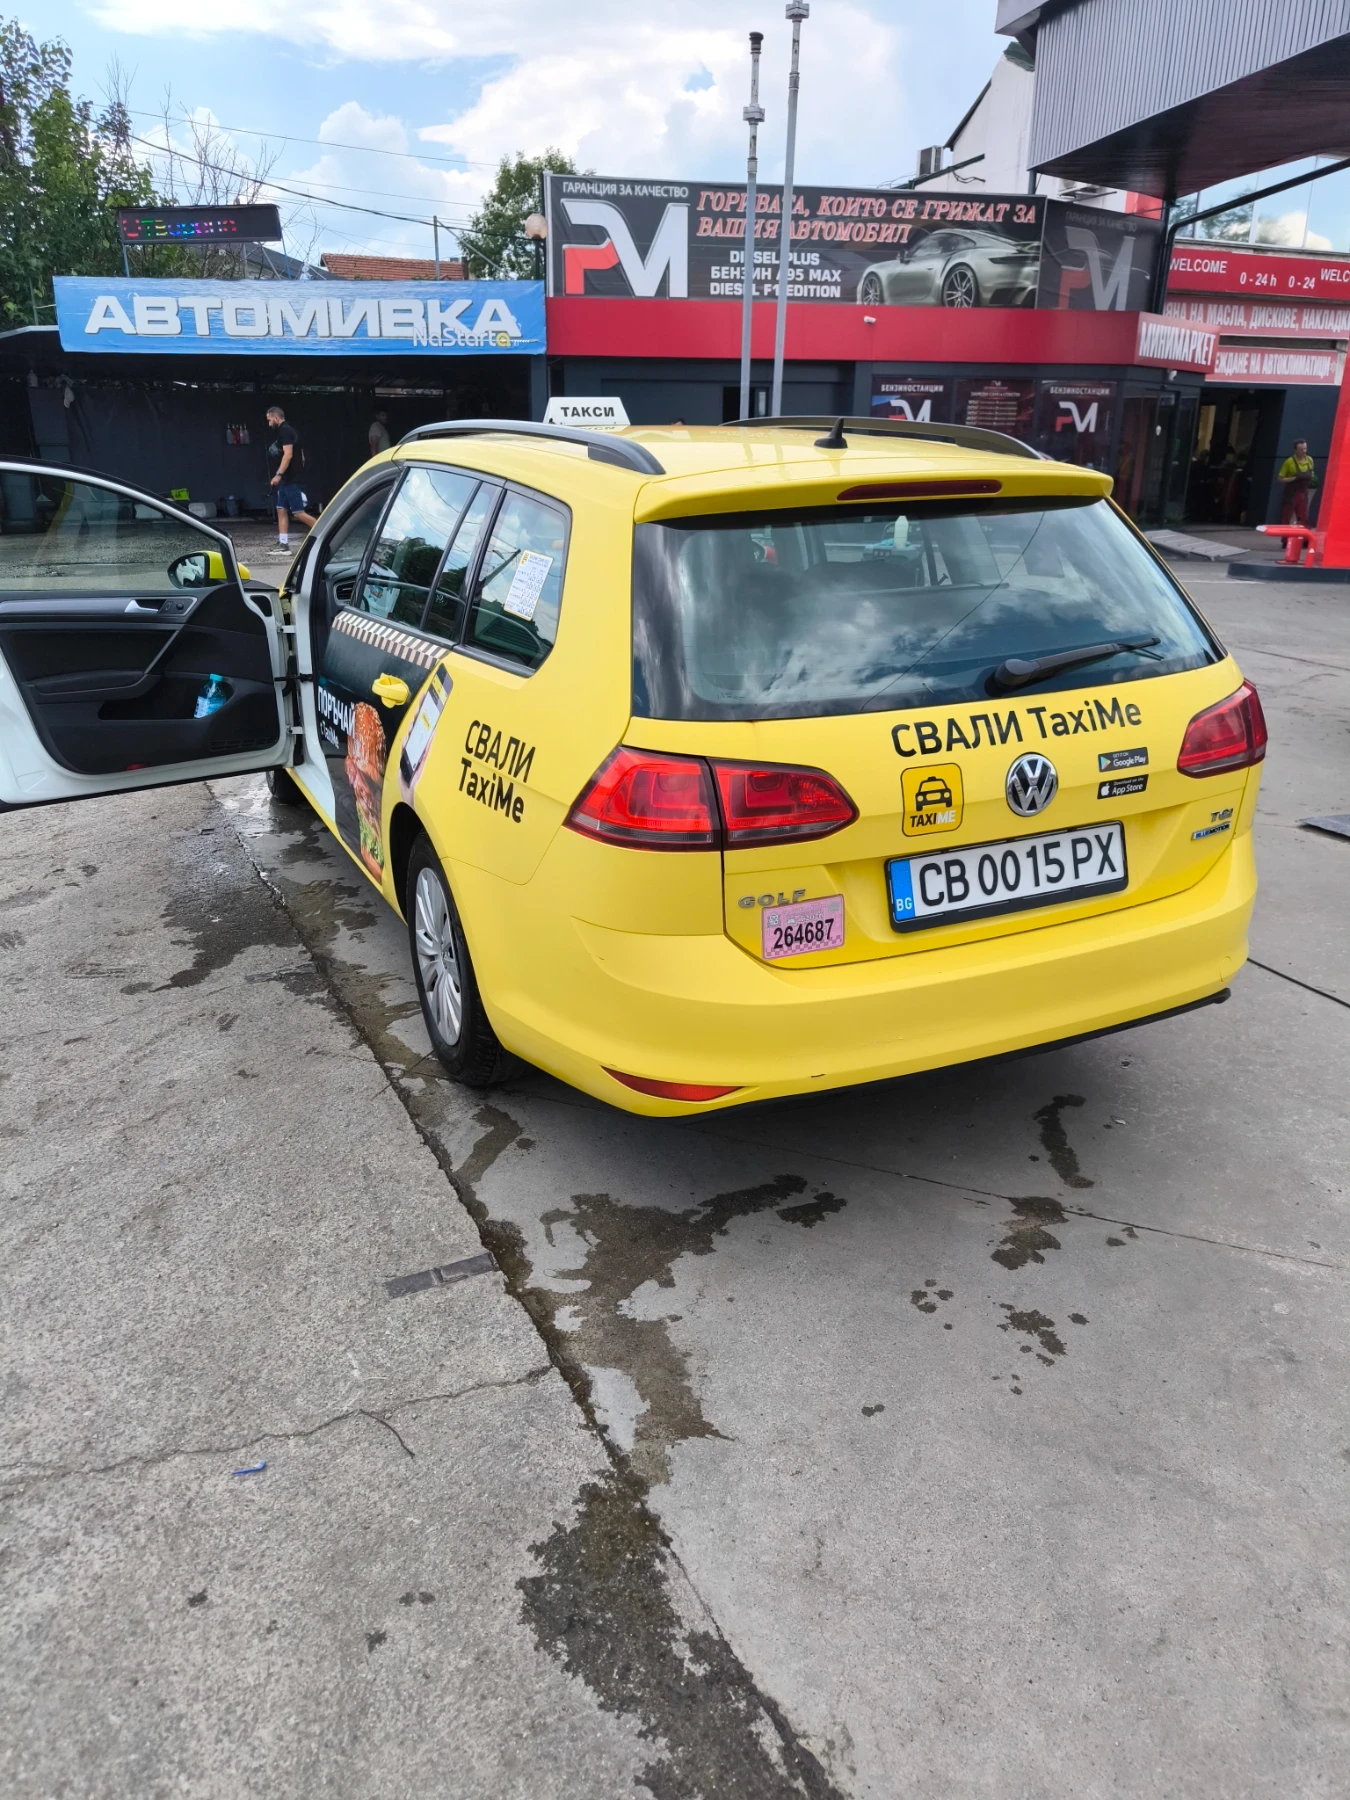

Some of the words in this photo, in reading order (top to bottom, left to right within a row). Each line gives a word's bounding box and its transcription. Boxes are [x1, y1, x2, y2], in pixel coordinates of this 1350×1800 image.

[562, 181, 617, 197] ГАРАНЦИЯ
[618, 184, 633, 196] ЗА
[634, 185, 689, 198] КАЧЕСТВО
[891, 199, 918, 219] СЕ
[920, 200, 1010, 222] ГРИЖАТ
[1012, 204, 1036, 223] ЗА
[729, 250, 780, 265] DISEL
[1170, 257, 1228, 274] WELCOME
[709, 282, 760, 296] DIESL
[1255, 273, 1268, 286] 24
[1269, 274, 1277, 287] h
[1302, 277, 1316, 290] 24
[84, 295, 523, 338] АВТОМИВКА
[1190, 303, 1204, 323] НА
[1207, 304, 1247, 329] МАСЛА,
[1249, 306, 1299, 331] ДИСКОВЕ,
[1138, 321, 1216, 366] МИНИМАРКЕТ
[1249, 353, 1262, 374] НА
[881, 384, 944, 393] БЕНЗИНОСТАНЦИИ
[560, 406, 615, 418] ТАКСИ
[891, 710, 1024, 757] СВАЛИ
[1026, 697, 1142, 739] TaxiMe
[465, 719, 536, 783] СВАЛИ
[1113, 756, 1135, 768] Google
[1134, 755, 1147, 764] Play
[459, 757, 525, 823] TaxiMe
[1112, 786, 1126, 795] App
[1126, 783, 1143, 793] Store
[910, 809, 957, 828] TAXIME
[738, 889, 806, 909] GOLF
[896, 898, 913, 912] BG
[773, 918, 834, 949] 264687
